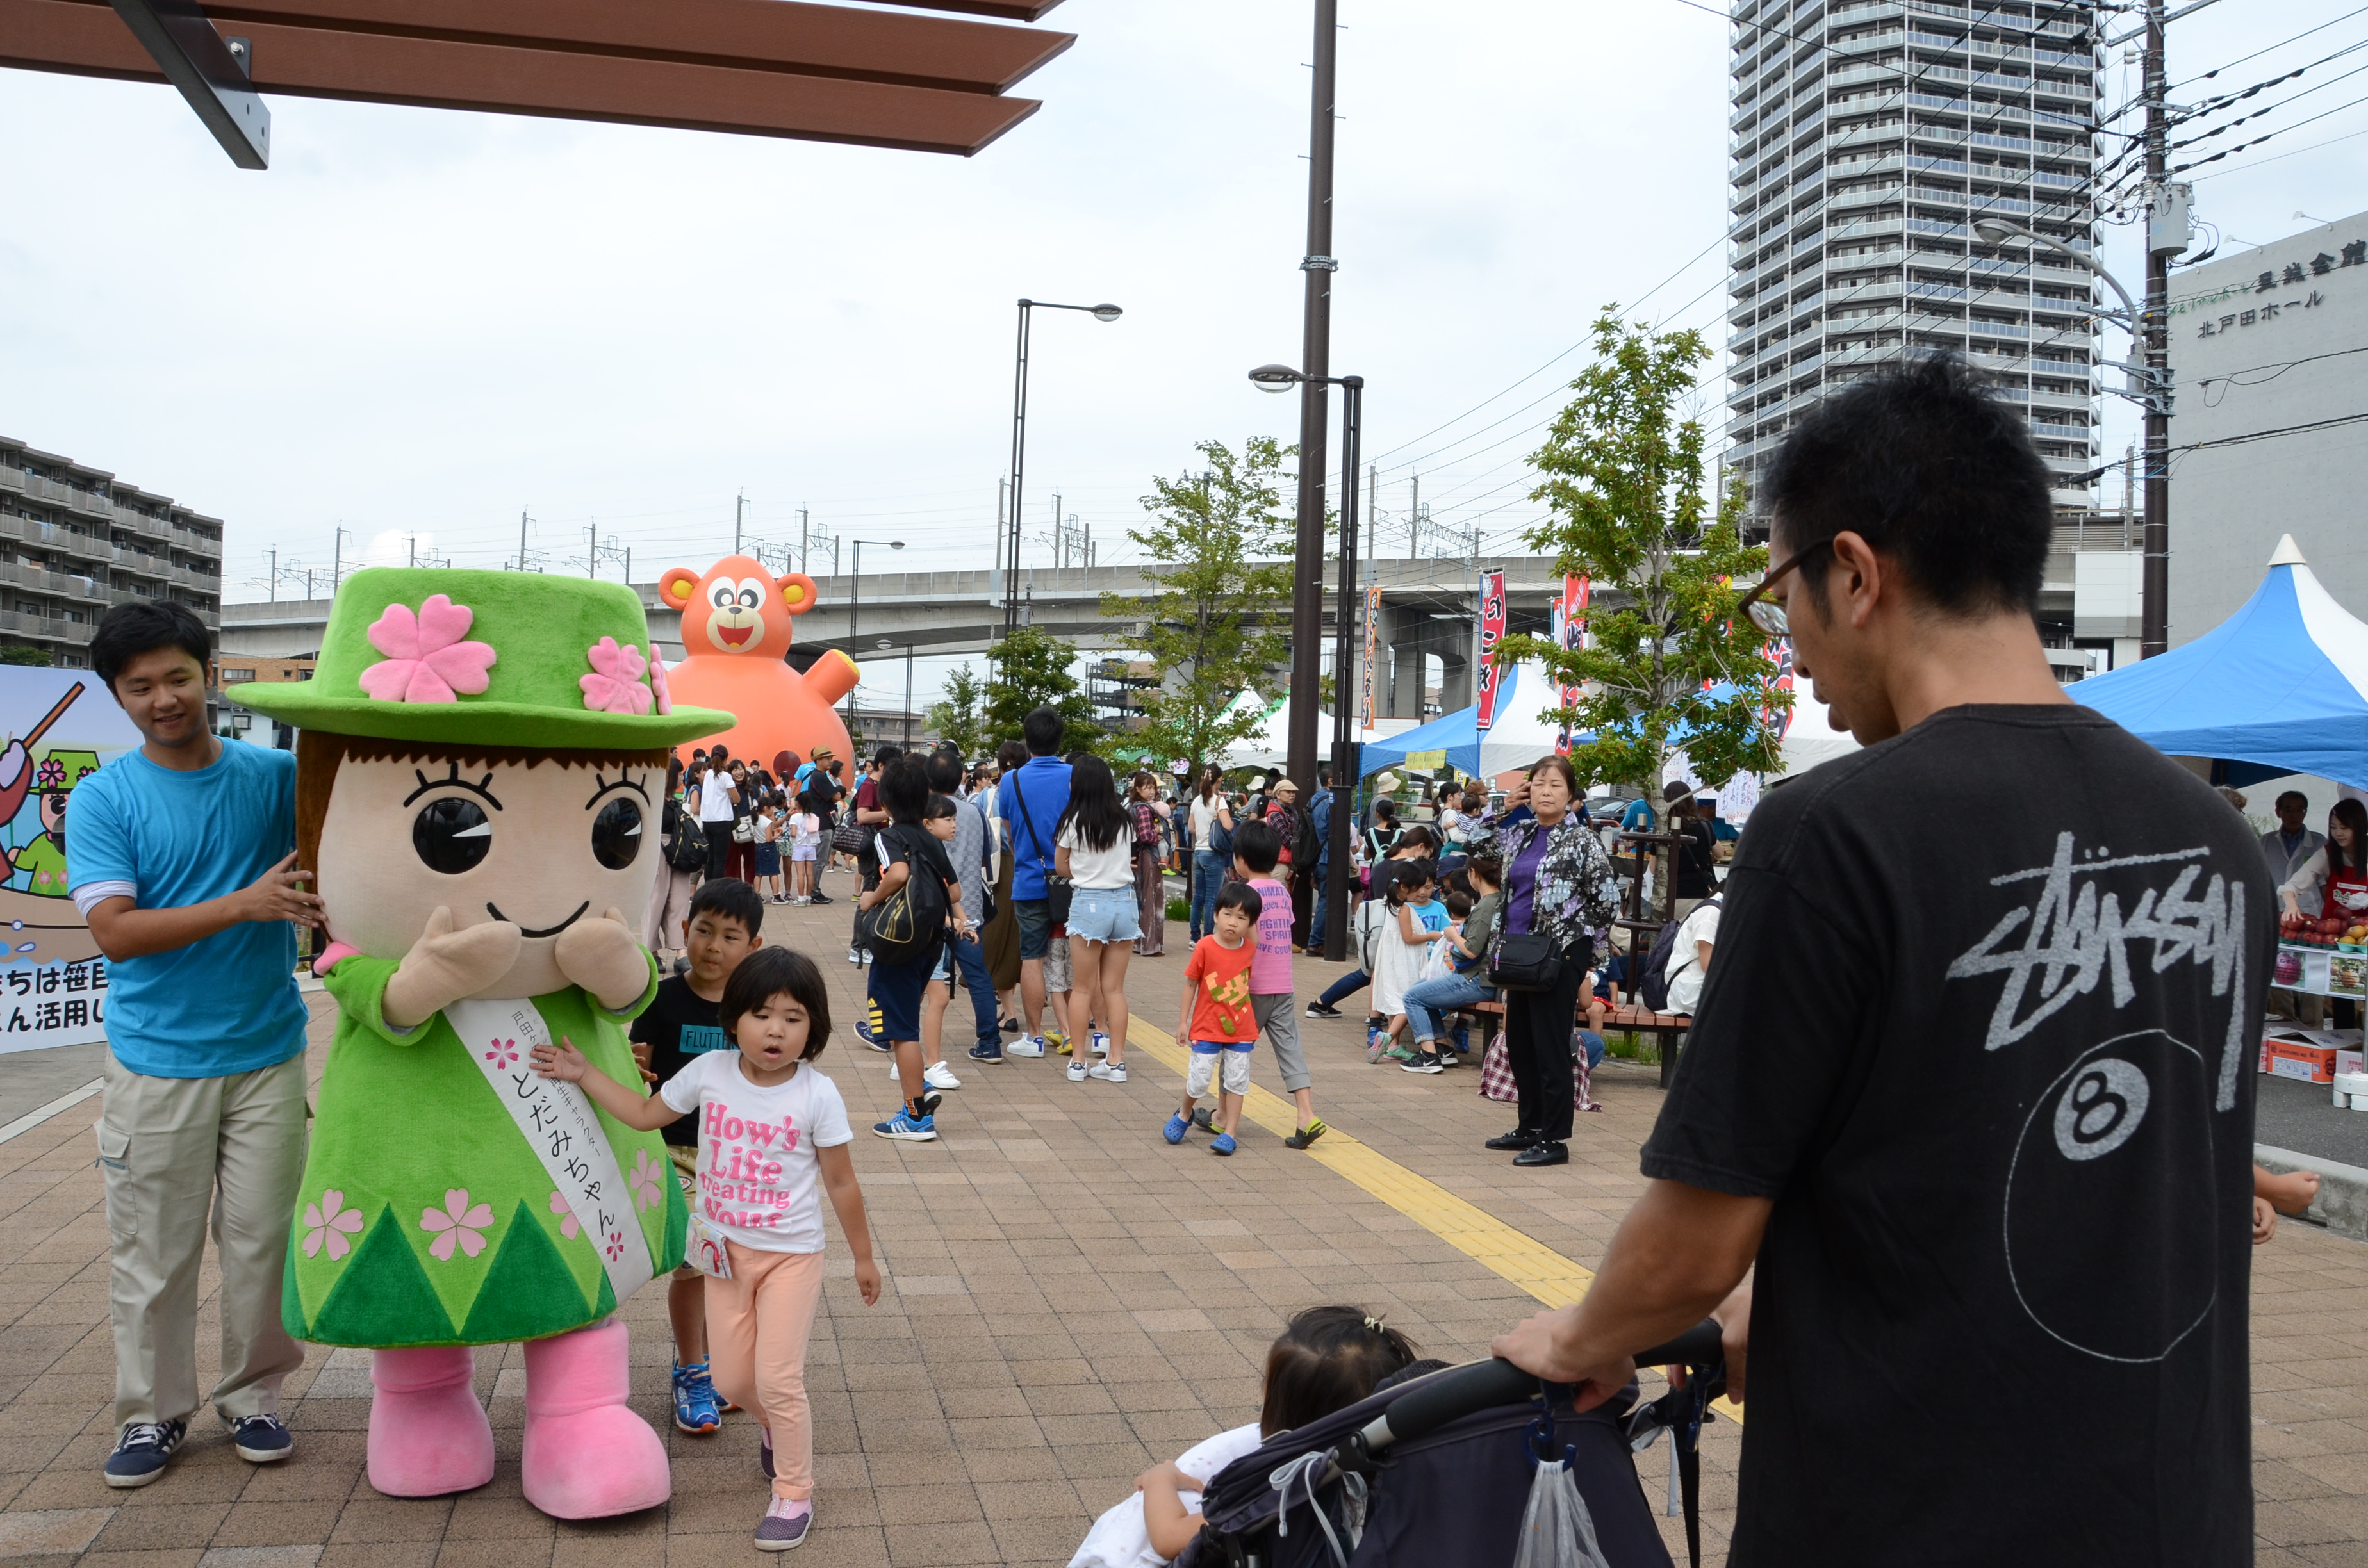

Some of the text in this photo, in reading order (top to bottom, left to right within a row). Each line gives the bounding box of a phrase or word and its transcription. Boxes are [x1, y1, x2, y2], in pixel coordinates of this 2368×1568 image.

[2197, 290, 2324, 339] 北戸田ホール
[1256, 886, 1290, 898] NIMAT
[1418, 915, 1438, 931] ST
[0, 962, 110, 997] ちは笹目
[0, 999, 104, 1033] ん活用し
[686, 1030, 734, 1050] FLUTTE
[704, 1101, 801, 1152] How's
[2072, 1070, 2128, 1145] 8
[511, 1072, 614, 1237] とだみちゃん
[708, 1139, 782, 1185] Life
[698, 1171, 791, 1210] treating
